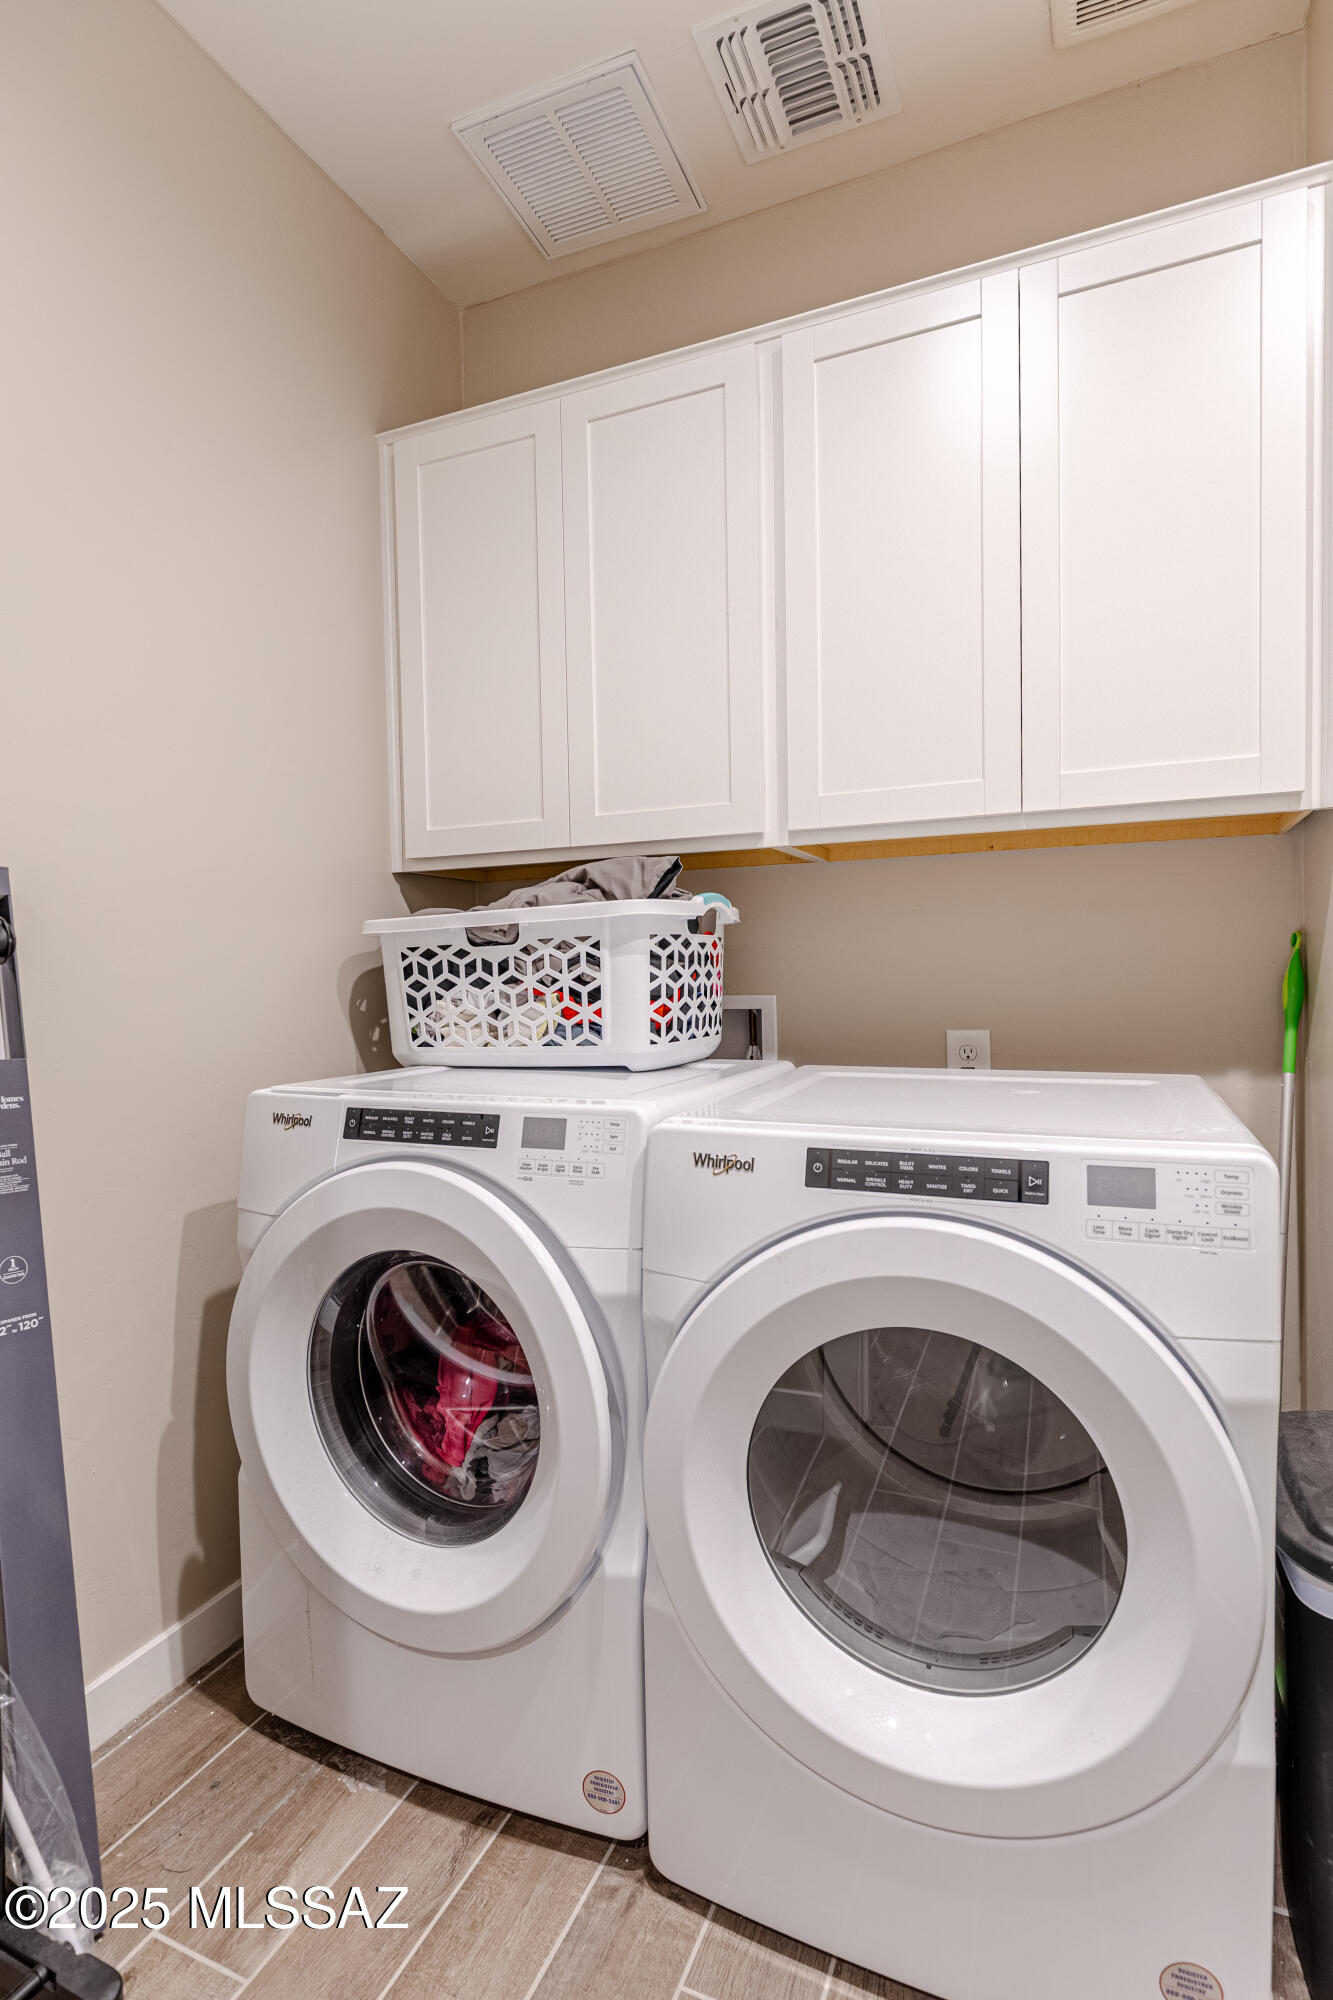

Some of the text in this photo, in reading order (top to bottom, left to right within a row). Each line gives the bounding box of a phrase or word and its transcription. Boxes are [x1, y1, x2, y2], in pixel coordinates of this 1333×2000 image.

[272, 1112, 313, 1130] Whirlpool
[0, 1149, 11, 1158] all
[12, 1156, 27, 1165] Rod
[693, 1152, 755, 1175] Whirlpool
[10, 1258, 15, 1268] 1
